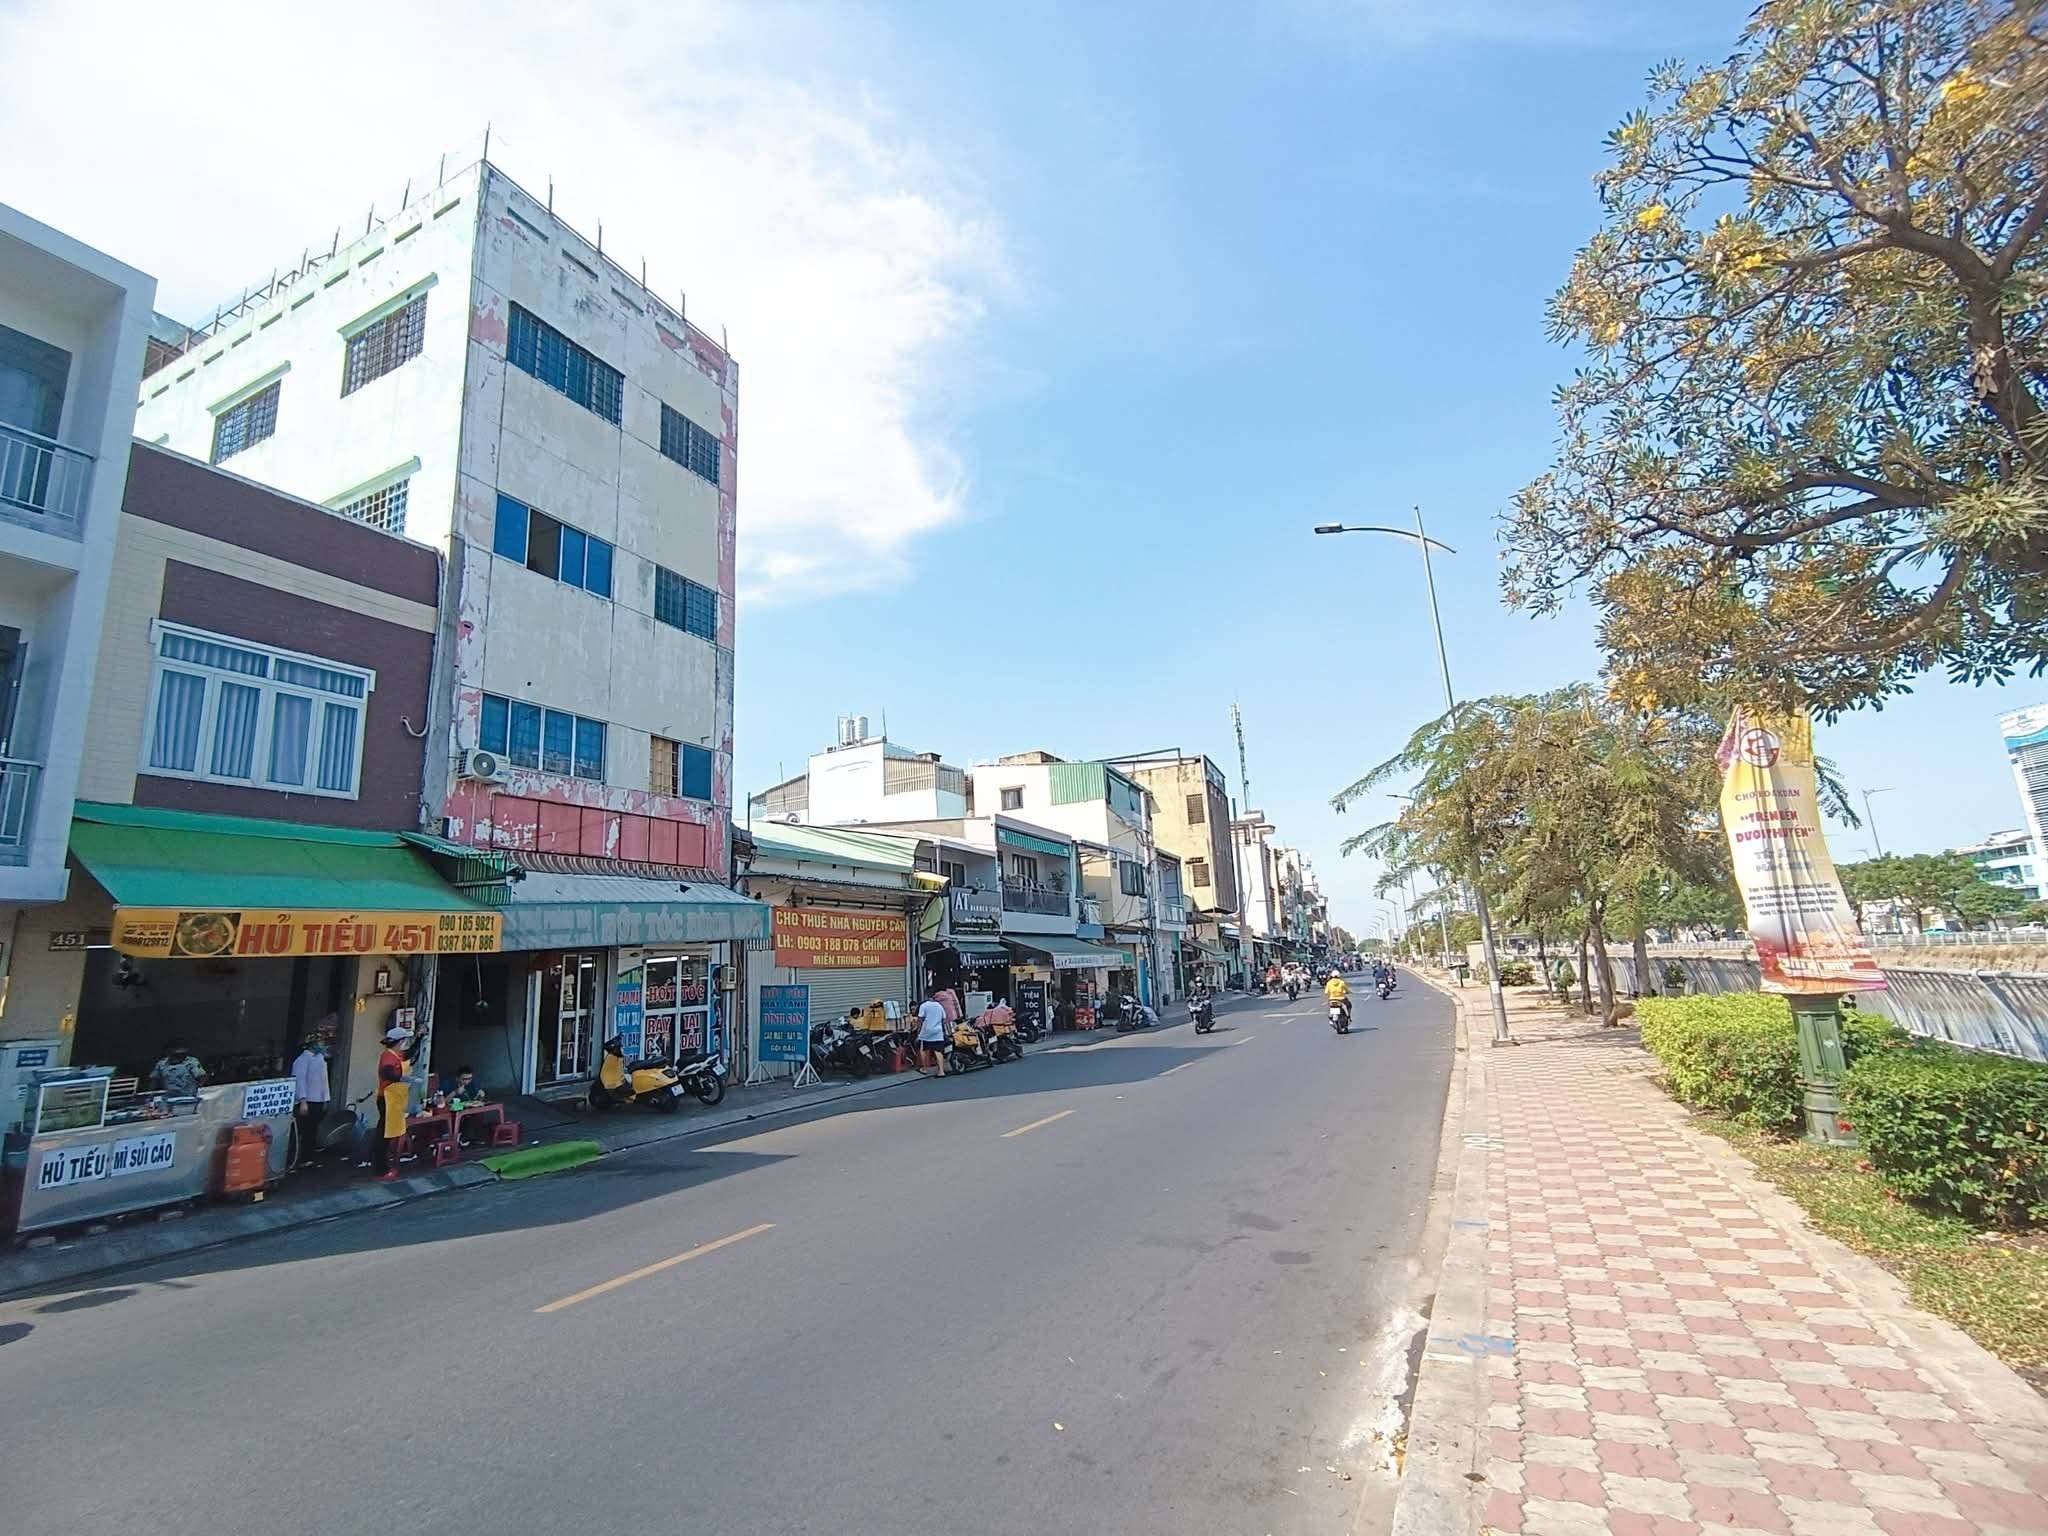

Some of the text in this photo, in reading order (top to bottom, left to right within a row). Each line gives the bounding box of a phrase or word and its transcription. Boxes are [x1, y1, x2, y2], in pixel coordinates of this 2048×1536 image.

[954, 891, 970, 911] AT
[439, 914, 456, 931] 090
[458, 915, 473, 931] 185
[475, 915, 495, 932] 9821
[776, 911, 799, 926] CHO
[830, 914, 850, 930] NHÀ
[53, 933, 86, 946] 451
[237, 914, 436, 954] HỦ TIẾU 451
[797, 935, 821, 950] 0903
[843, 938, 860, 951] 078
[683, 1013, 700, 1030] TAI
[114, 1139, 172, 1169] MÌ SỦI CẢO
[41, 1147, 106, 1184] HỦ TIẾU
